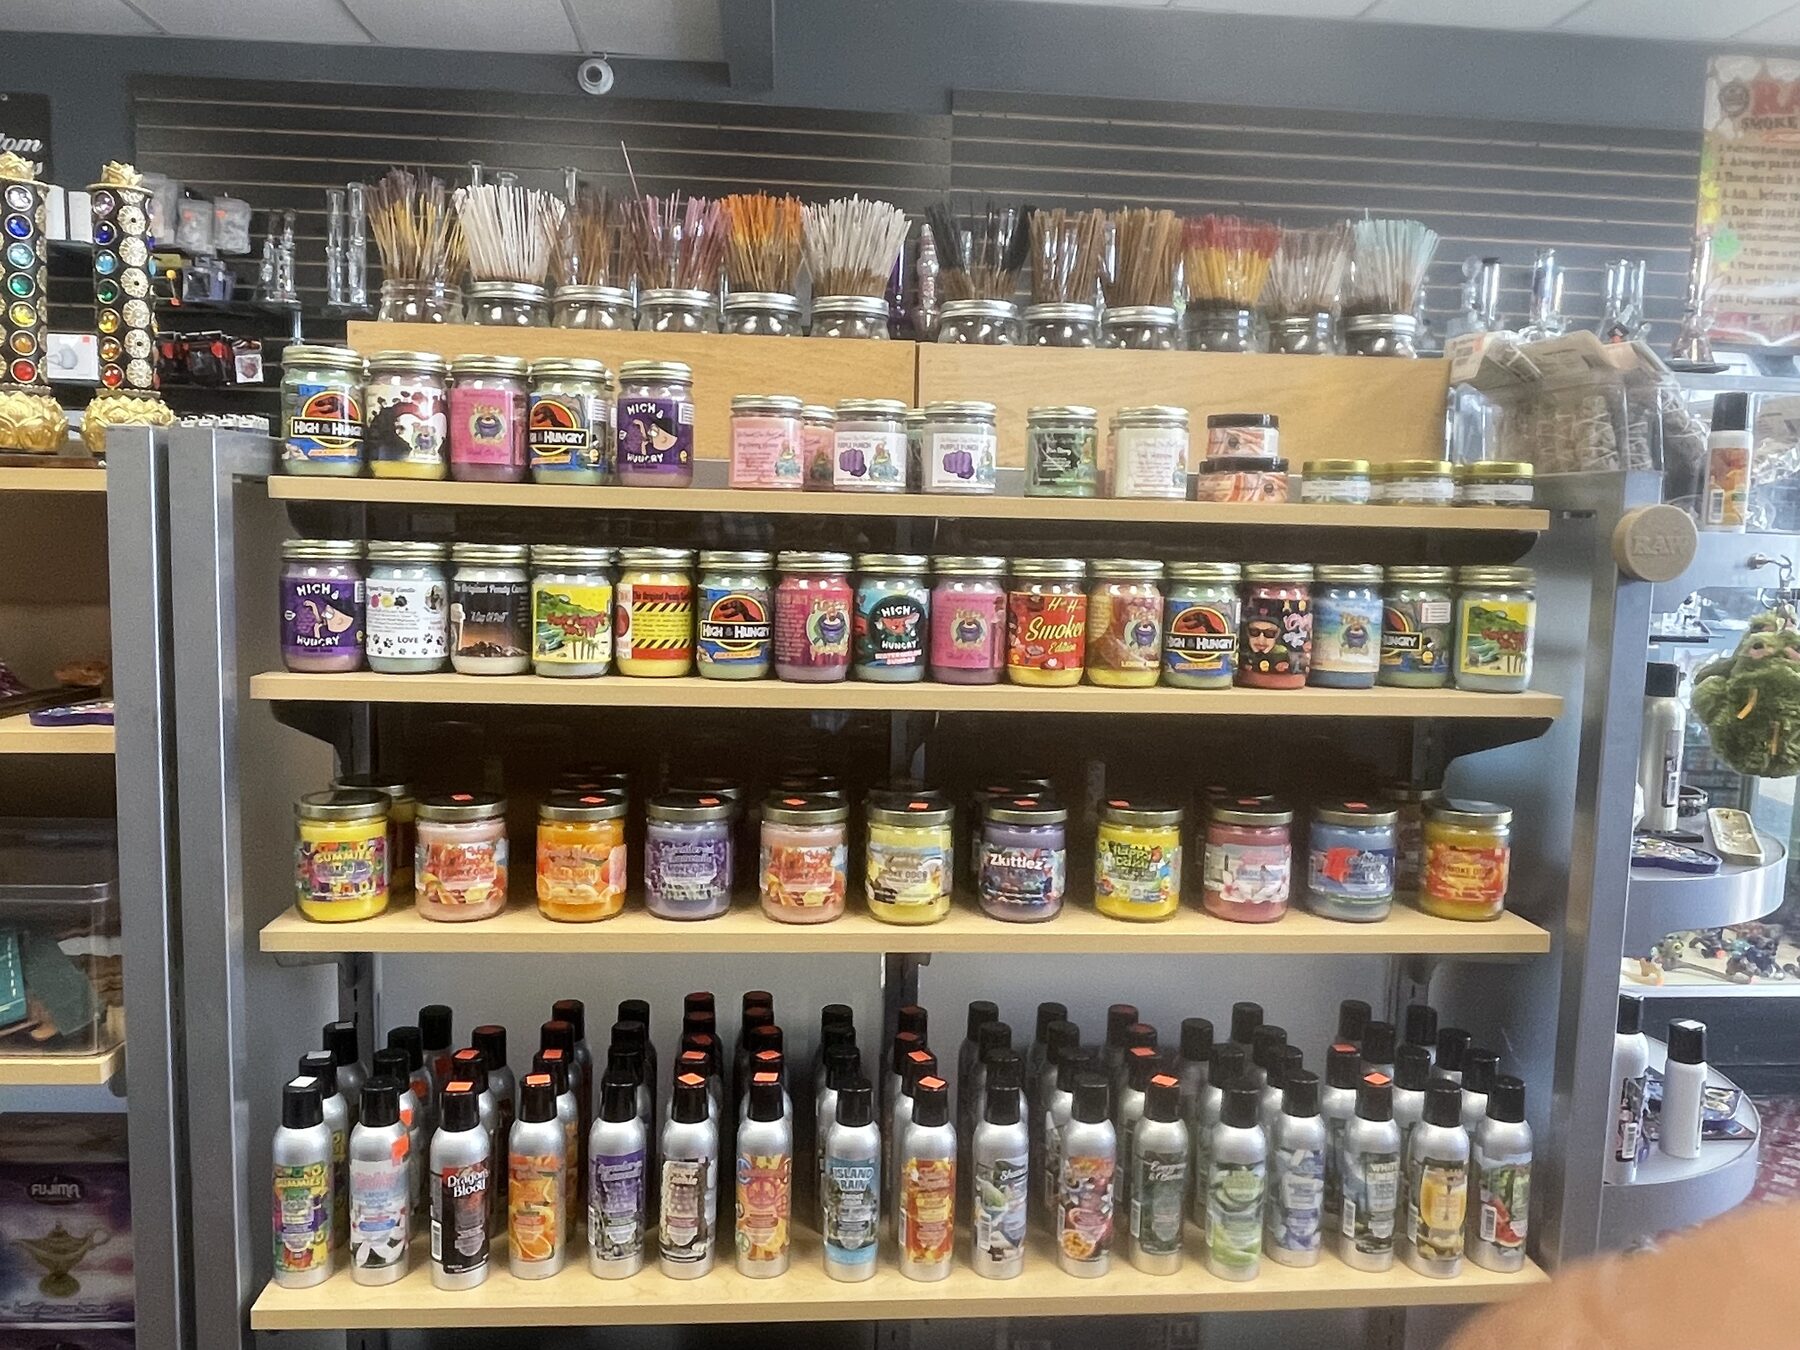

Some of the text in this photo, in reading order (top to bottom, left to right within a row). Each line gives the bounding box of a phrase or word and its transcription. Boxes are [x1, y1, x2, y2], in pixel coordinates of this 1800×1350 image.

[543, 431, 585, 444] HUNGRY
[397, 635, 419, 645] LOVE
[1382, 634, 1418, 647] UNGRY
[832, 1167, 875, 1180] ISLAND
[31, 1182, 82, 1199] FUJIMA
[453, 1179, 486, 1198] Blood
[839, 1179, 868, 1191] RAIN
